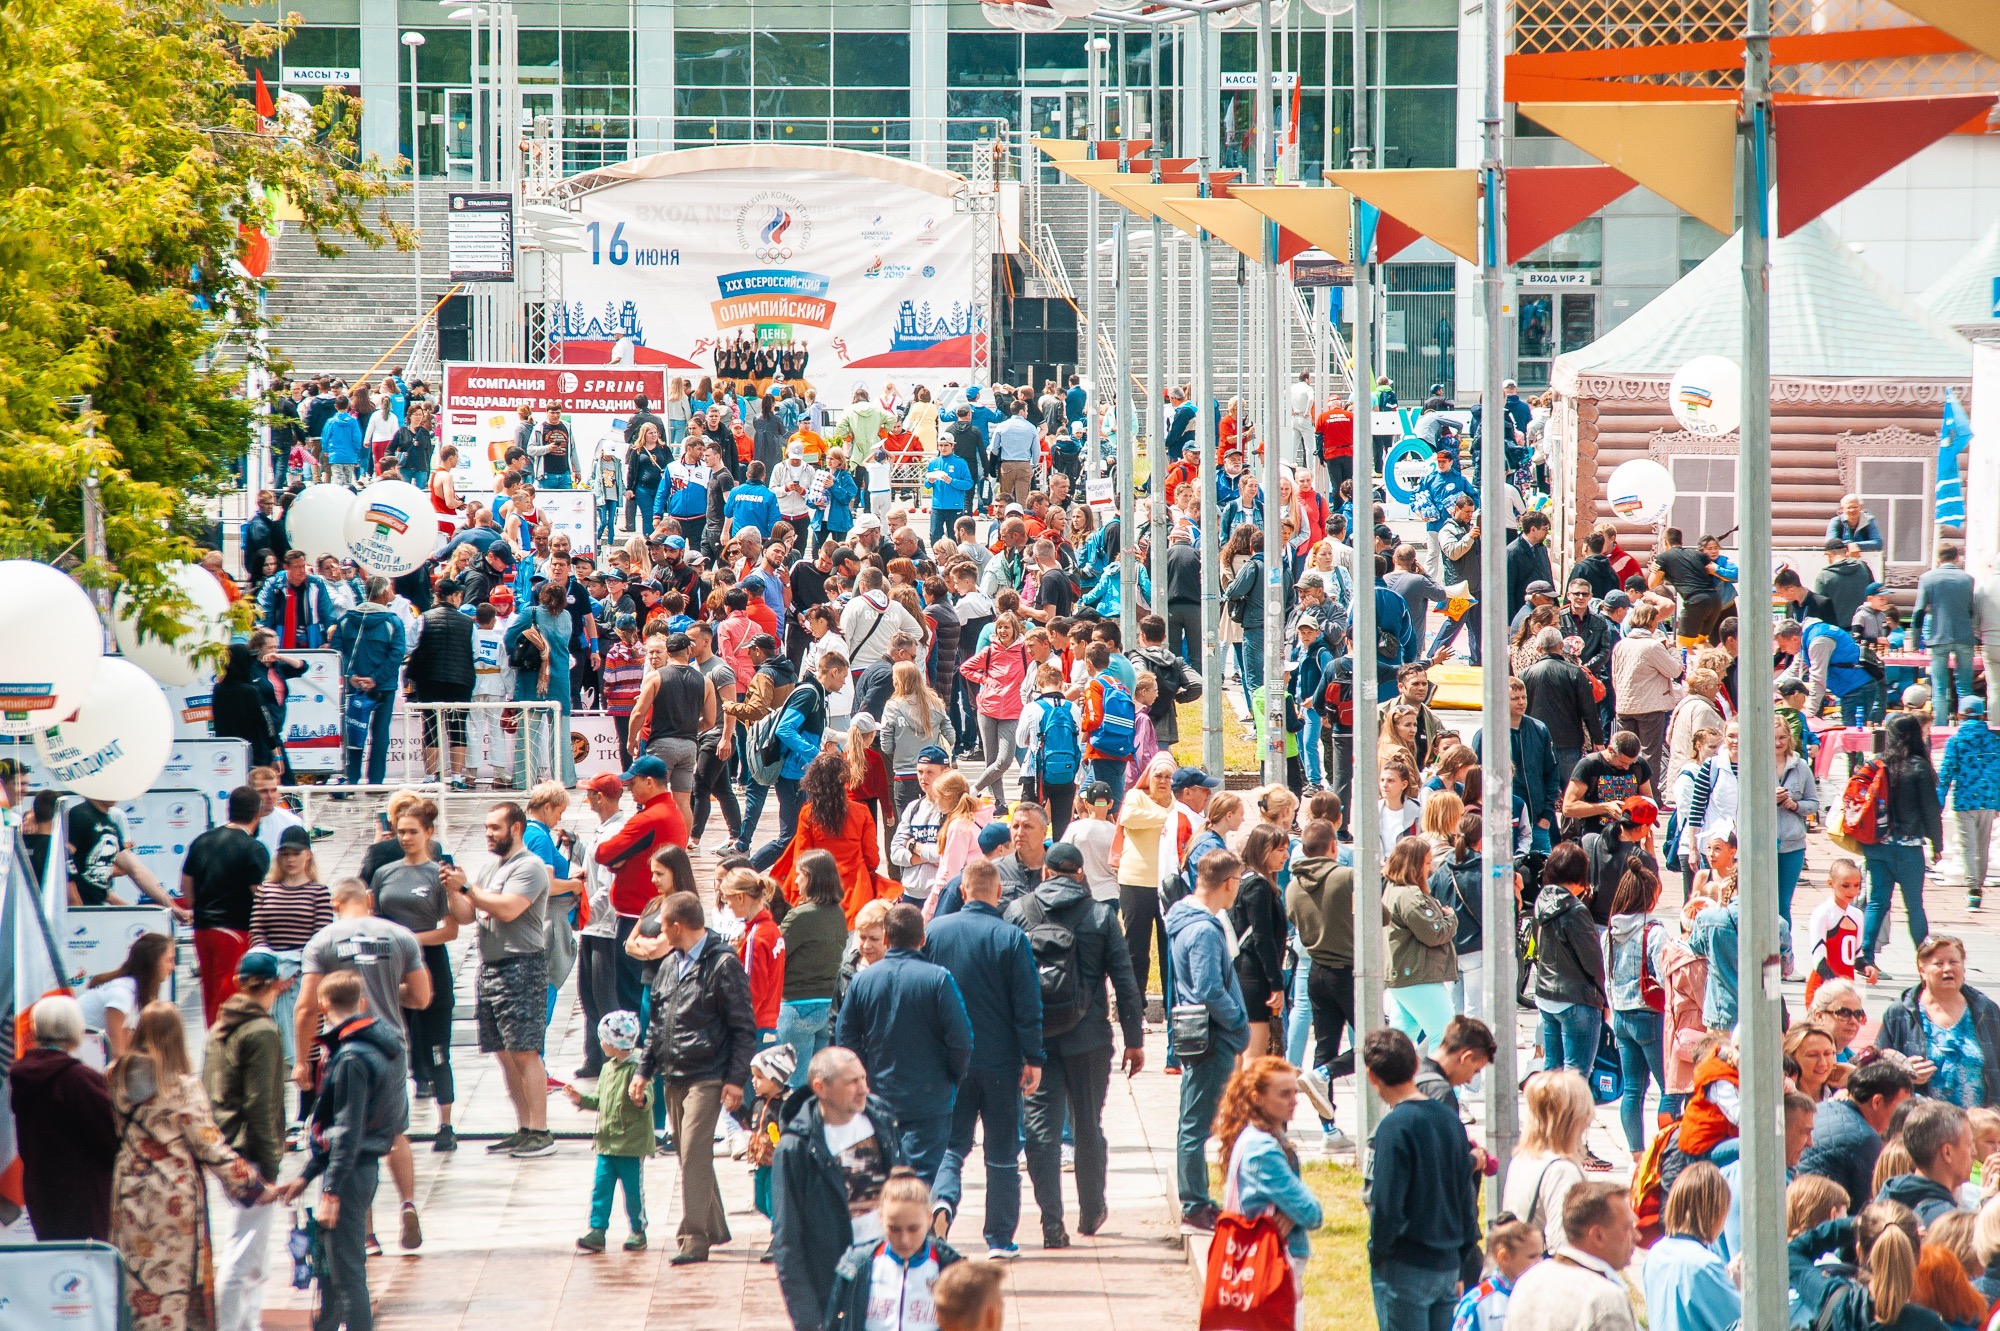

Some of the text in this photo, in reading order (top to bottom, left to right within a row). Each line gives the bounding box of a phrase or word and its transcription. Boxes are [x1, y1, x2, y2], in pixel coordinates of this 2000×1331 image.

[293, 70, 350, 79] КАССЫ 7-9
[737, 190, 812, 250] ОЛИМПИЙСКИЙ КОМИТЕТ РОССИИ
[586, 221, 629, 266] 16
[745, 275, 820, 292] ВСЕРОССИЙСКИЙ
[1530, 275, 1585, 283] ВХОД VIP 2
[720, 297, 827, 322] ОЛИМПИЙСКИЙ
[760, 328, 787, 340] ДЕНЬ
[468, 377, 545, 391] КОМПАНИЯ
[583, 380, 645, 393] SPRING
[450, 395, 536, 409] ПОЗДРАВЛЯЕТ
[564, 399, 573, 410] С
[575, 399, 662, 412] ПРАЗДНИМ!
[735, 494, 764, 503] RUSSIA
[355, 542, 401, 565] ФУТБОЛ И
[864, 609, 899, 621] RUSIA
[1840, 934, 1855, 966] 0
[1226, 1236, 1258, 1261] bye
[1221, 1261, 1255, 1286] bye
[1219, 1286, 1254, 1312] boy
